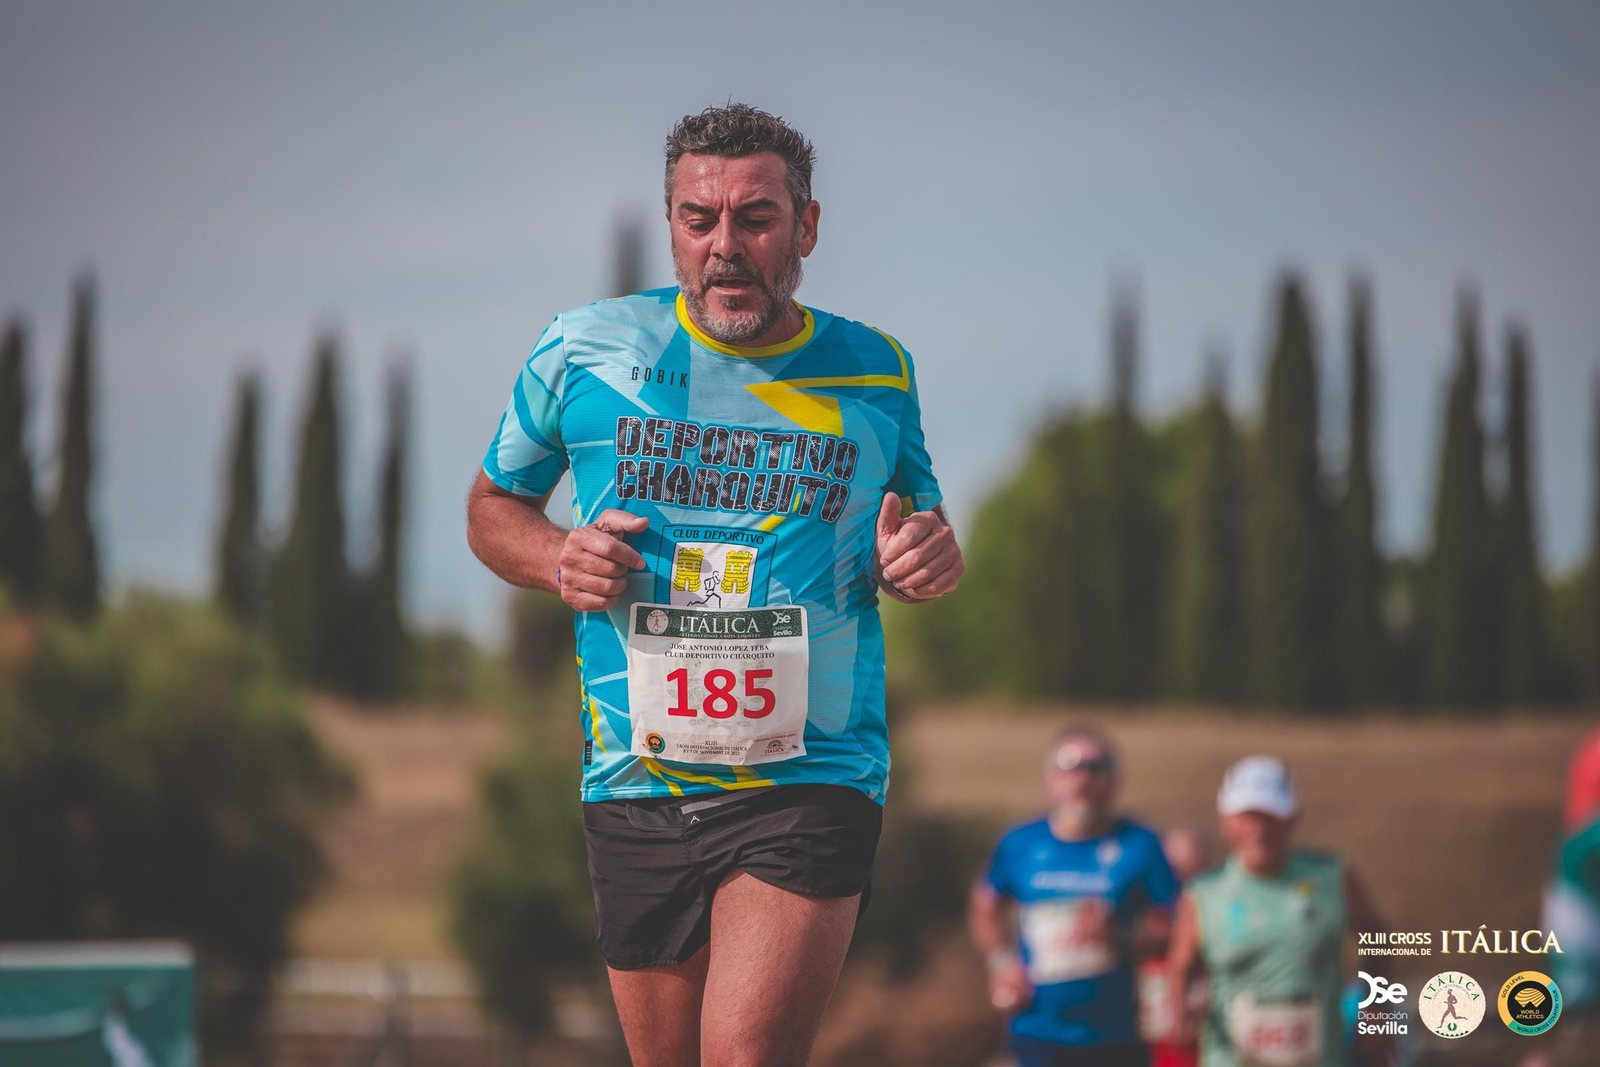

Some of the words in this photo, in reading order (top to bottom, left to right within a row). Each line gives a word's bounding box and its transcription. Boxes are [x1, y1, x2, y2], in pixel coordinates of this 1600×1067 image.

[631, 366, 688, 389] GOBIK
[616, 416, 859, 481] DEPORTIVO
[616, 460, 850, 523] CHARQUITO
[673, 528, 699, 540] CLUB
[703, 530, 765, 545] DEPORTIVO
[680, 613, 760, 634] ITÁLICA
[685, 652, 728, 660] DEPORTIVO
[730, 652, 775, 660] CHARQUITO
[667, 668, 776, 719] 185
